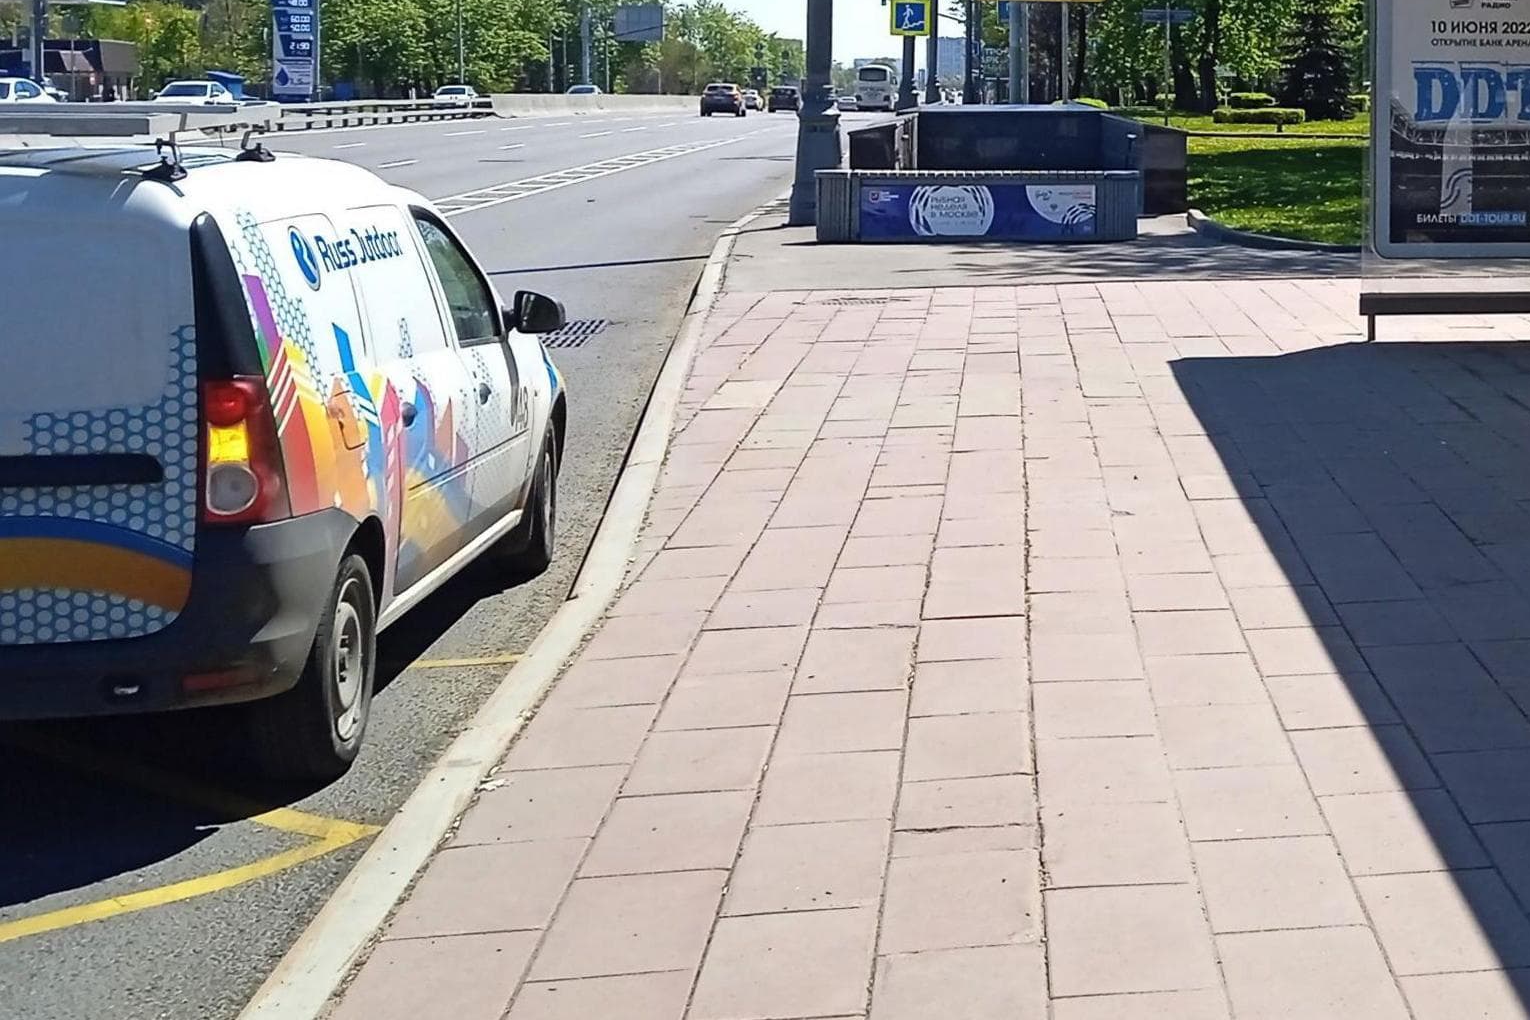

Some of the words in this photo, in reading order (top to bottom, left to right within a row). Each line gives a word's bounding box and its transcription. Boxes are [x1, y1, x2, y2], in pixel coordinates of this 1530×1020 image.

[1430, 21, 1447, 34] 10
[1451, 21, 1498, 34] ИЮНЯ
[1431, 38, 1476, 47] ОТКРЫТИЕ
[1479, 39, 1503, 47] БАНК
[1417, 214, 1457, 223] БИЛЕТЫ
[314, 235, 358, 273] Russ
